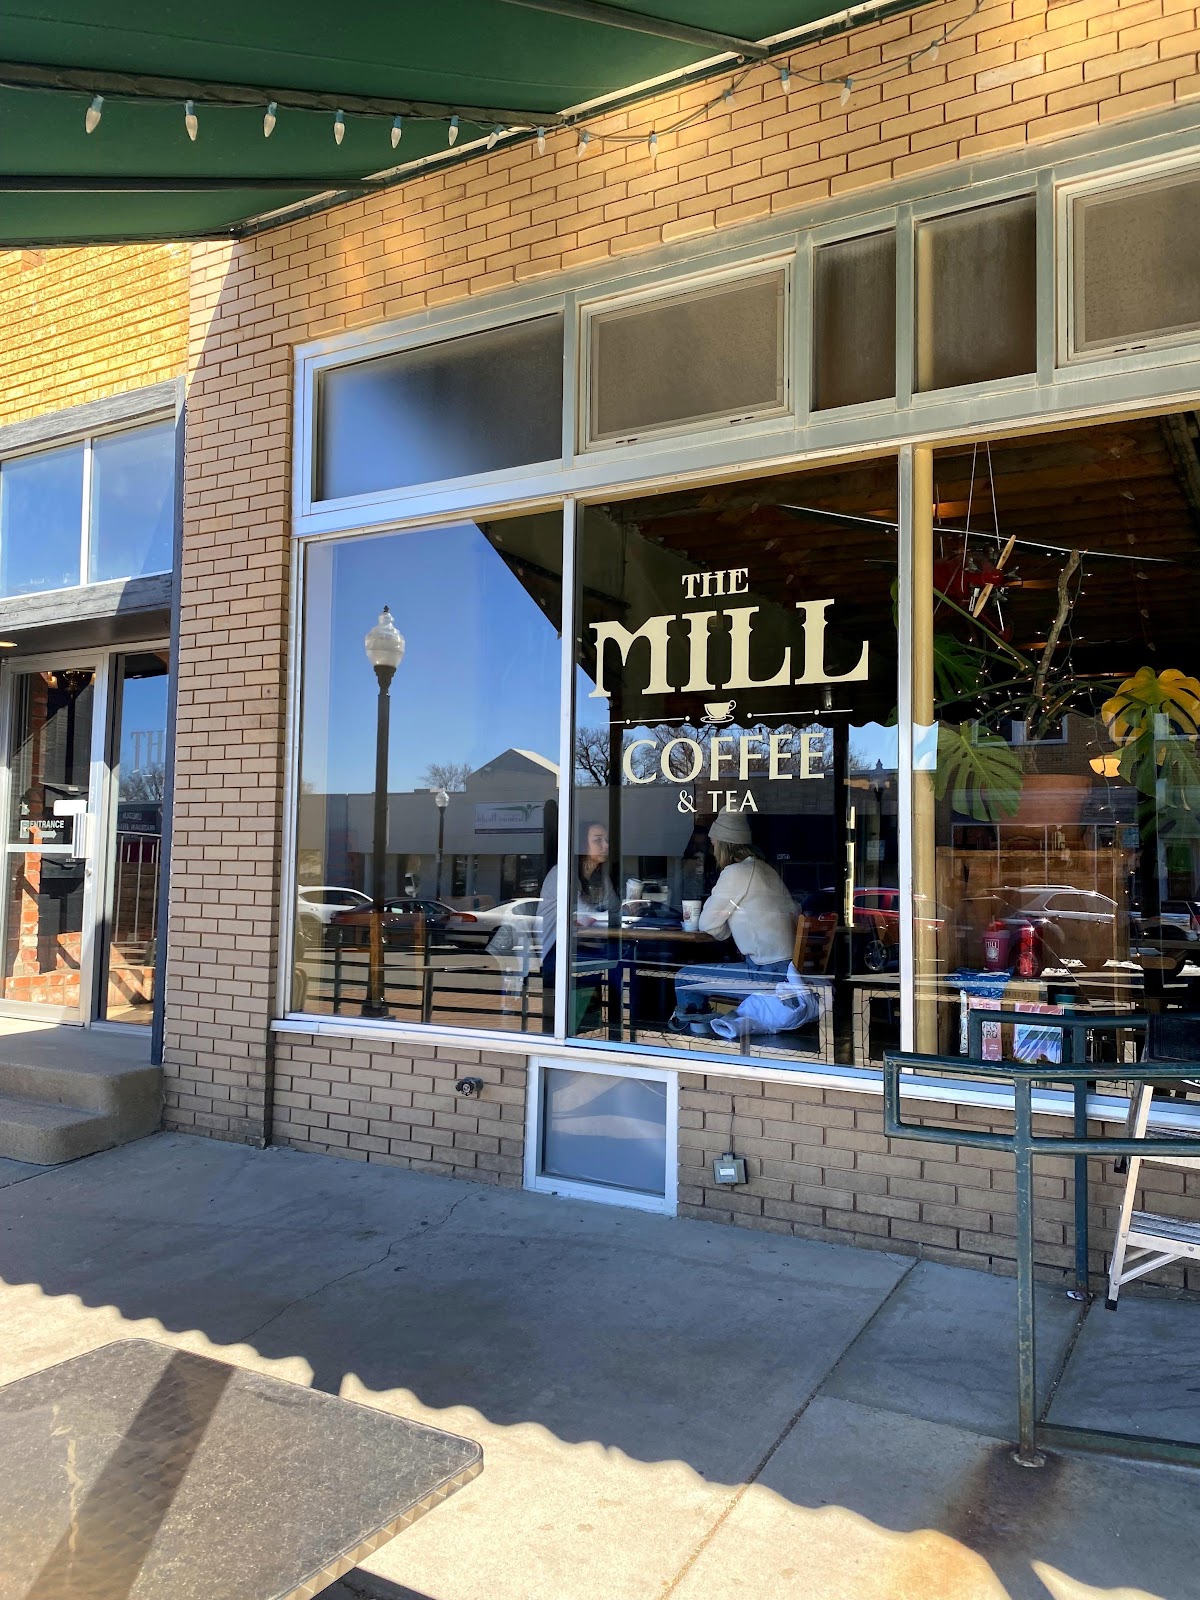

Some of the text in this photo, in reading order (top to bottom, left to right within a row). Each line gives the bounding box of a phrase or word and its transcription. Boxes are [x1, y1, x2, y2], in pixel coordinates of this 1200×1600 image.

[682, 567, 749, 599] THE
[588, 598, 870, 698] MILL
[622, 732, 825, 784] COFFEE
[677, 789, 759, 813] & TEA
[29, 820, 65, 829] ENTRANCE
